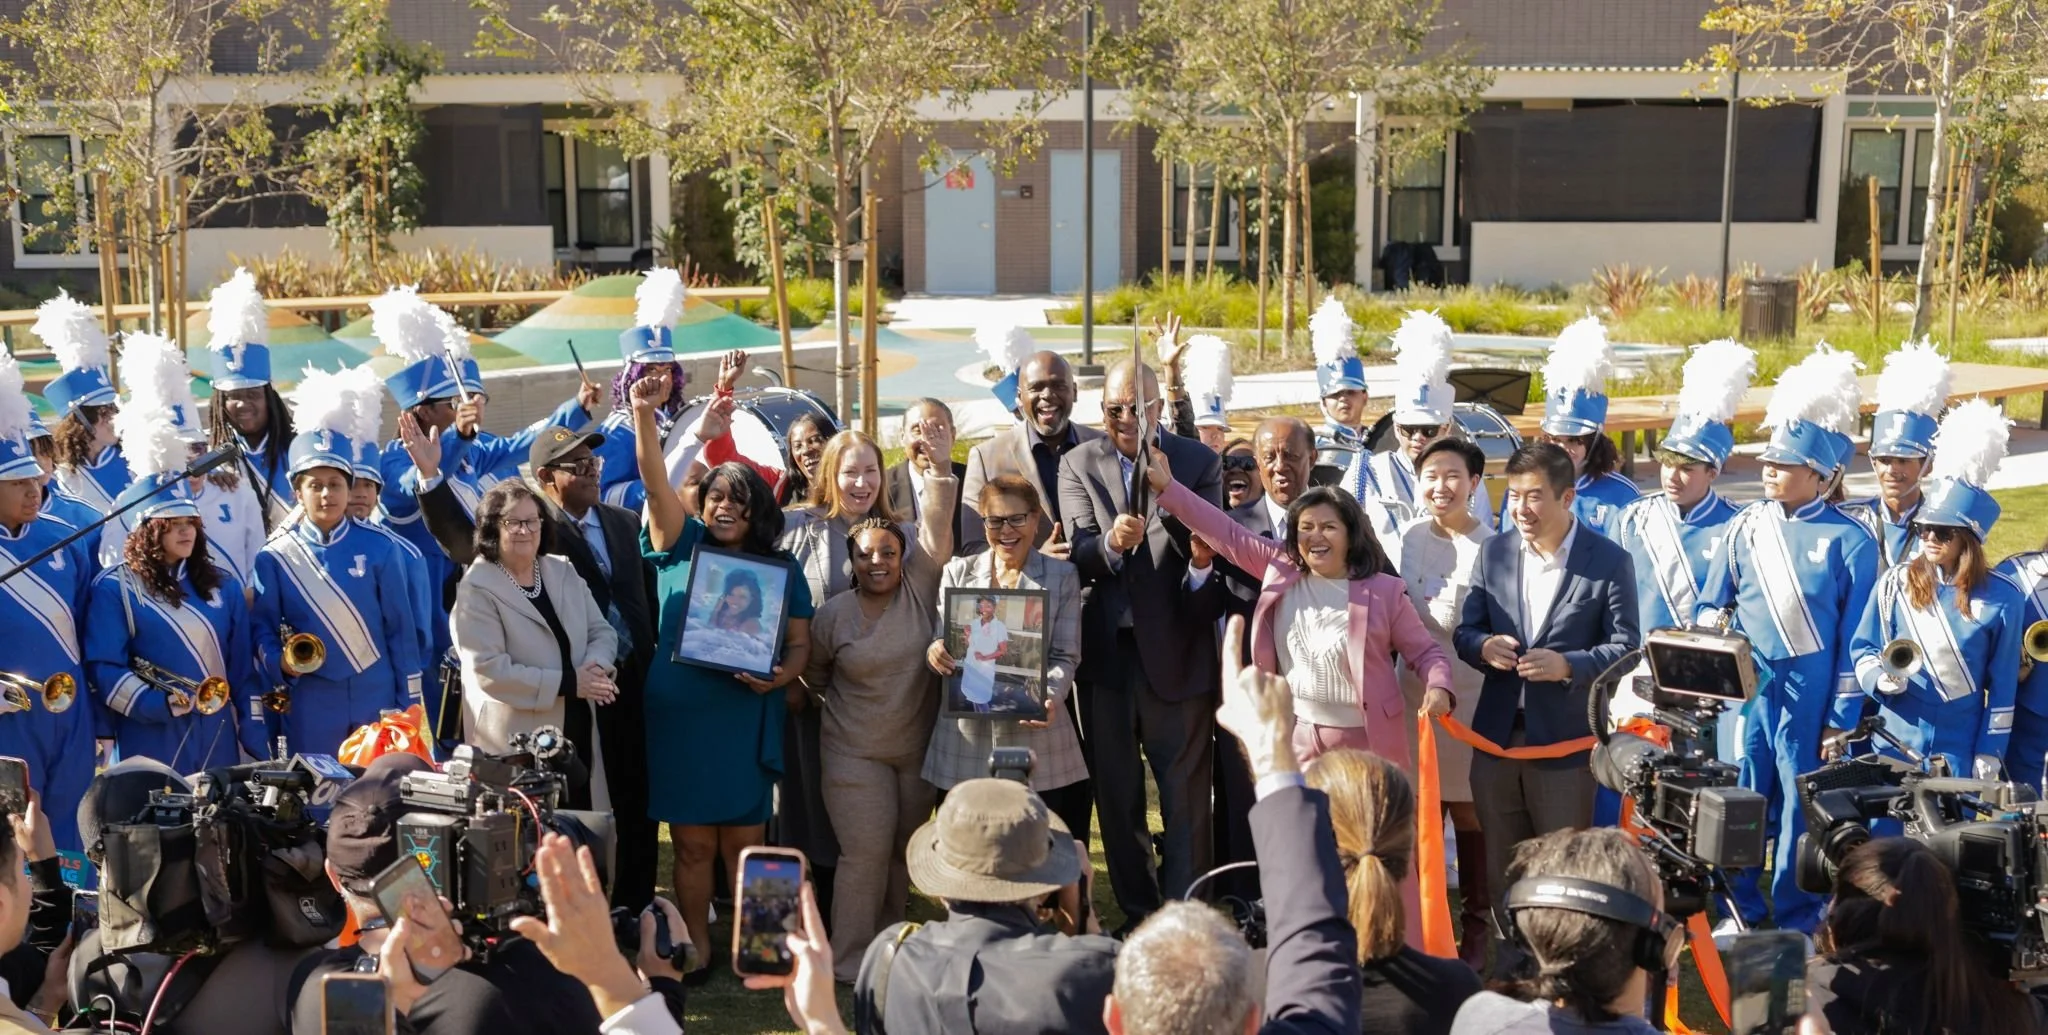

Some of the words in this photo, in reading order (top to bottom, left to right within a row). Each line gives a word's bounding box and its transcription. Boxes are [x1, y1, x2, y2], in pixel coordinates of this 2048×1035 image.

[172, 404, 185, 426] J
[1210, 396, 1221, 412] J
[314, 429, 334, 451] J
[219, 504, 233, 523] J
[1589, 504, 1608, 526] J
[1702, 536, 1721, 560] J
[1808, 537, 1831, 563] J
[348, 554, 368, 578] J
